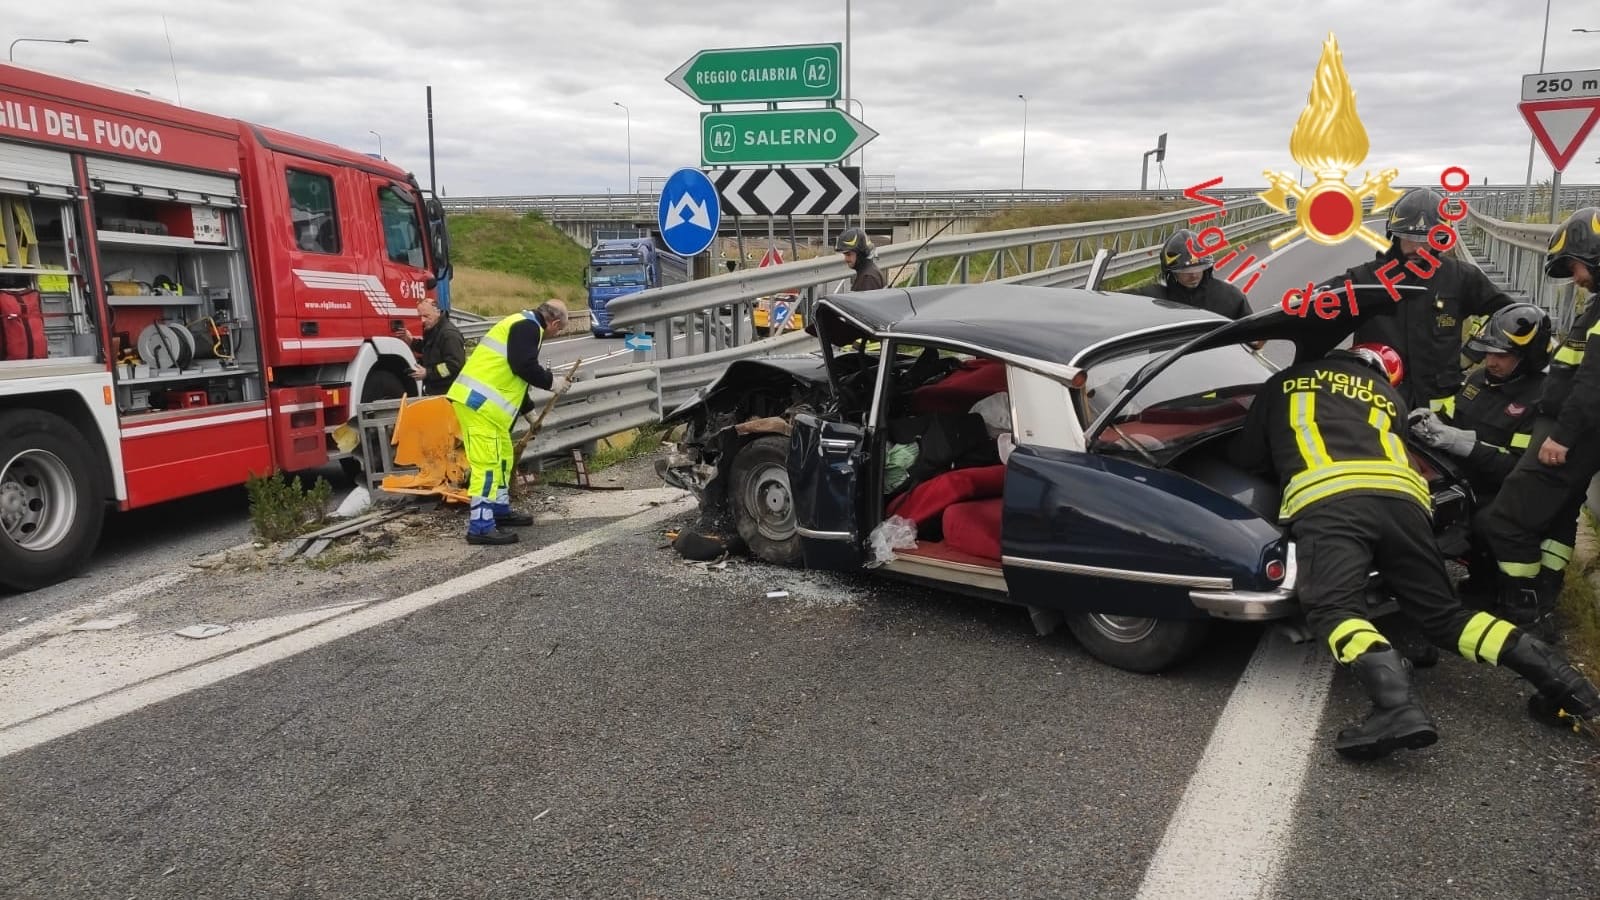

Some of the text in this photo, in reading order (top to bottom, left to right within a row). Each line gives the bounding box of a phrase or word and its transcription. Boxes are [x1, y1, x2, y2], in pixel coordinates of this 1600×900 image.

[696, 64, 826, 85] REGGIO CALABRIA A2
[1537, 78, 1598, 93] 250 m
[44, 108, 89, 142] DEL
[93, 118, 162, 155] FUOCO
[714, 128, 837, 147] A2 SALERNO
[410, 280, 425, 299] 115
[1315, 370, 1374, 391] VIGILI
[1283, 378, 1397, 416] DEL FUOCO
